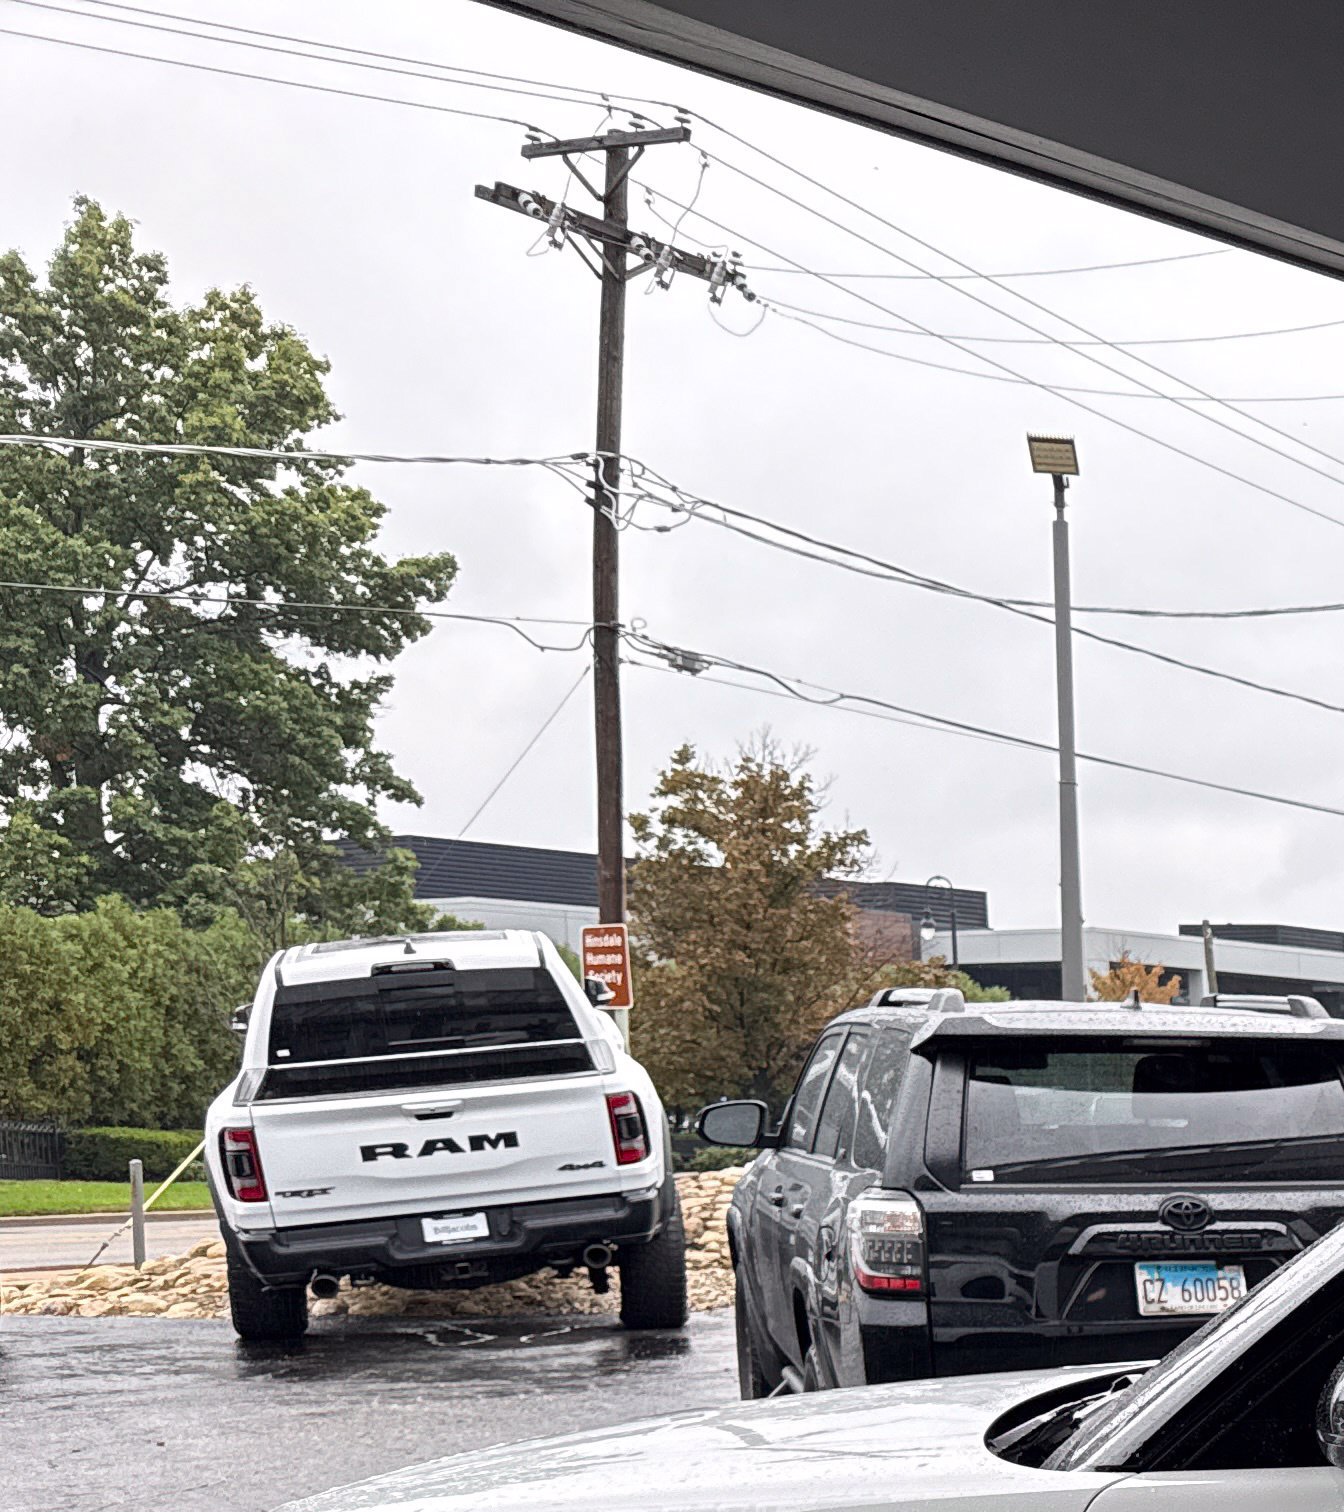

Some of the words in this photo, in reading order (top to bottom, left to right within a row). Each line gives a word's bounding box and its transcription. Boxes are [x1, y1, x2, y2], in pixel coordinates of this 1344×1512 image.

[586, 952, 623, 966] Humane
[360, 1131, 520, 1162] RAM
[1143, 1278, 1168, 1304] CZ
[1181, 1277, 1241, 1302] 60058
